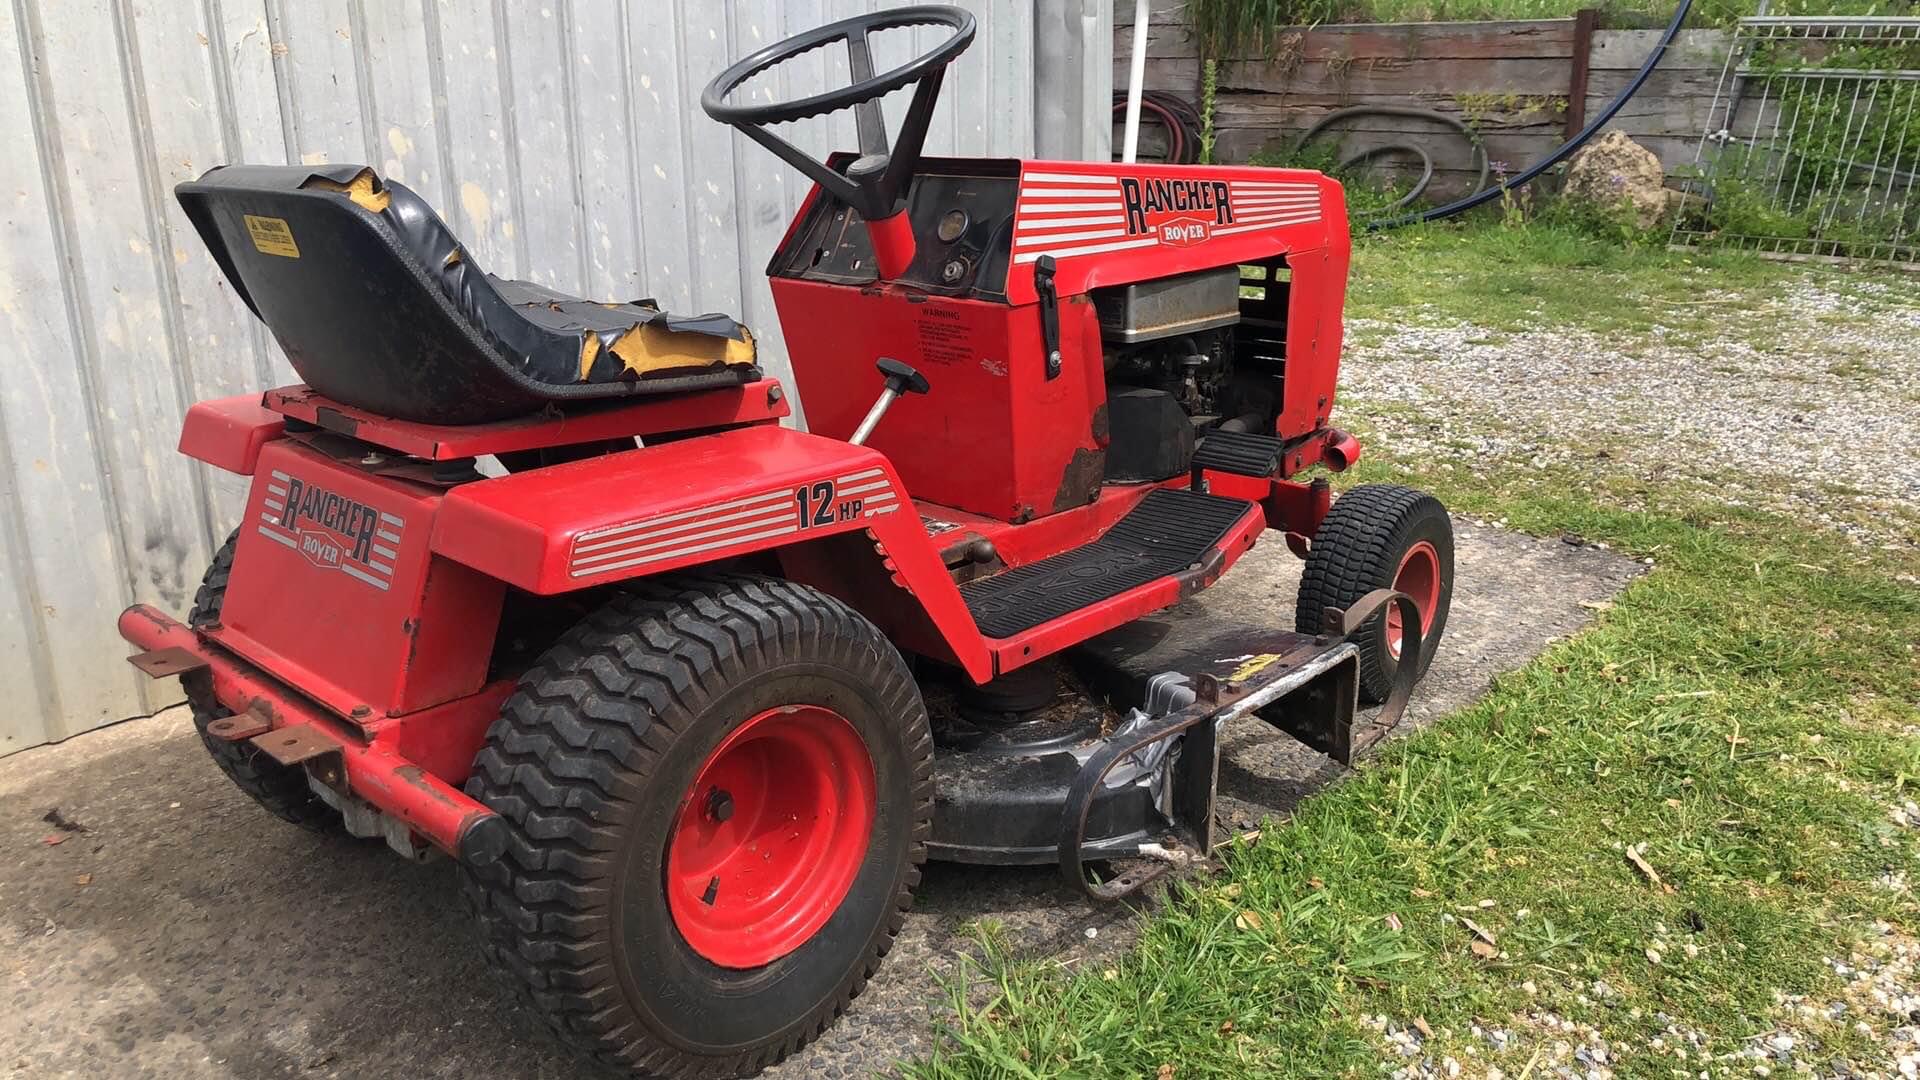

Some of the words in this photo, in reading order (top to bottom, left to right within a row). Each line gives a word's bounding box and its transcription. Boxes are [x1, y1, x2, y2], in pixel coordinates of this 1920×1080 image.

[1121, 178, 1233, 234] RANCHER
[1165, 222, 1205, 240] ROVER
[921, 307, 960, 320] WARNING
[281, 478, 377, 563] RANCHER
[796, 481, 835, 529] 12
[839, 500, 863, 521] HP
[303, 535, 338, 564] ROVER
